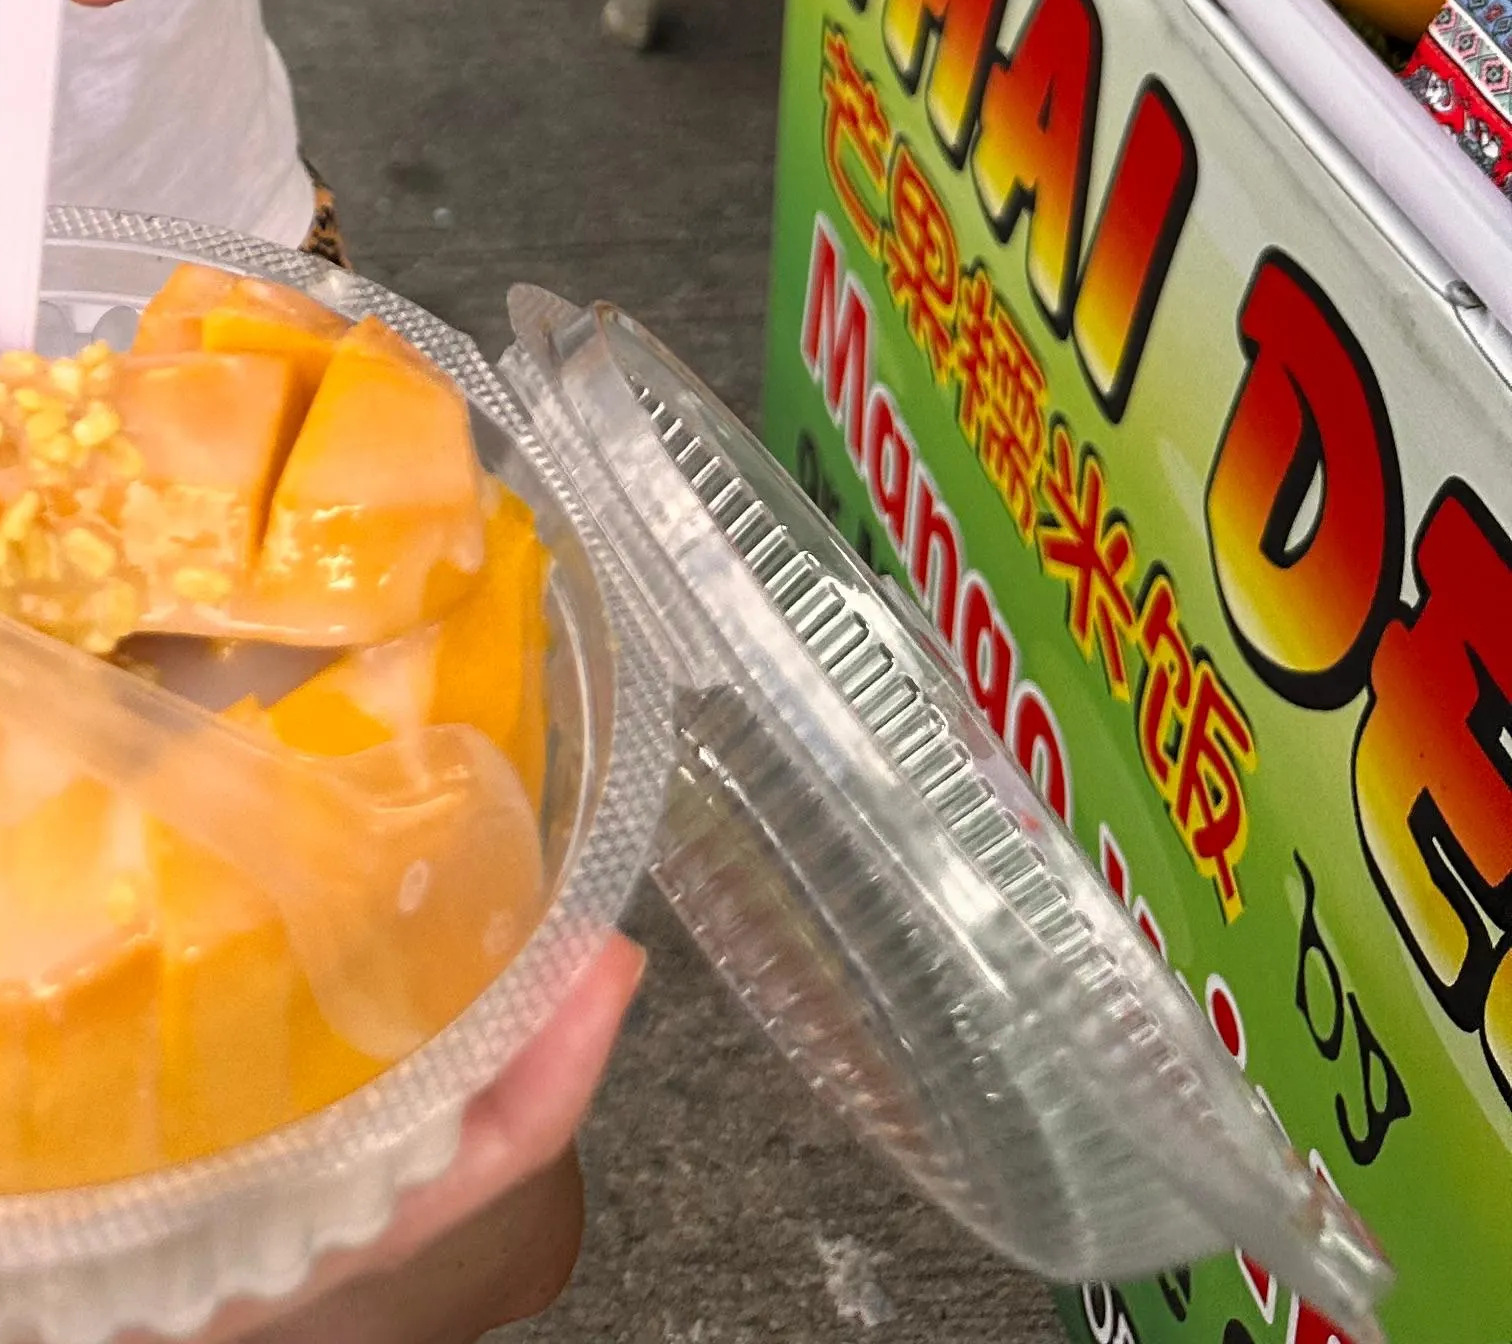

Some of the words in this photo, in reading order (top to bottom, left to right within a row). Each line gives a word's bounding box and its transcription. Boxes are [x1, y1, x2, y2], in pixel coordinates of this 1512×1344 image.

[822, 16, 1255, 925] 芒果糯米饭
[1205, 245, 1512, 1112] DE
[1293, 848, 1412, 1166] by
